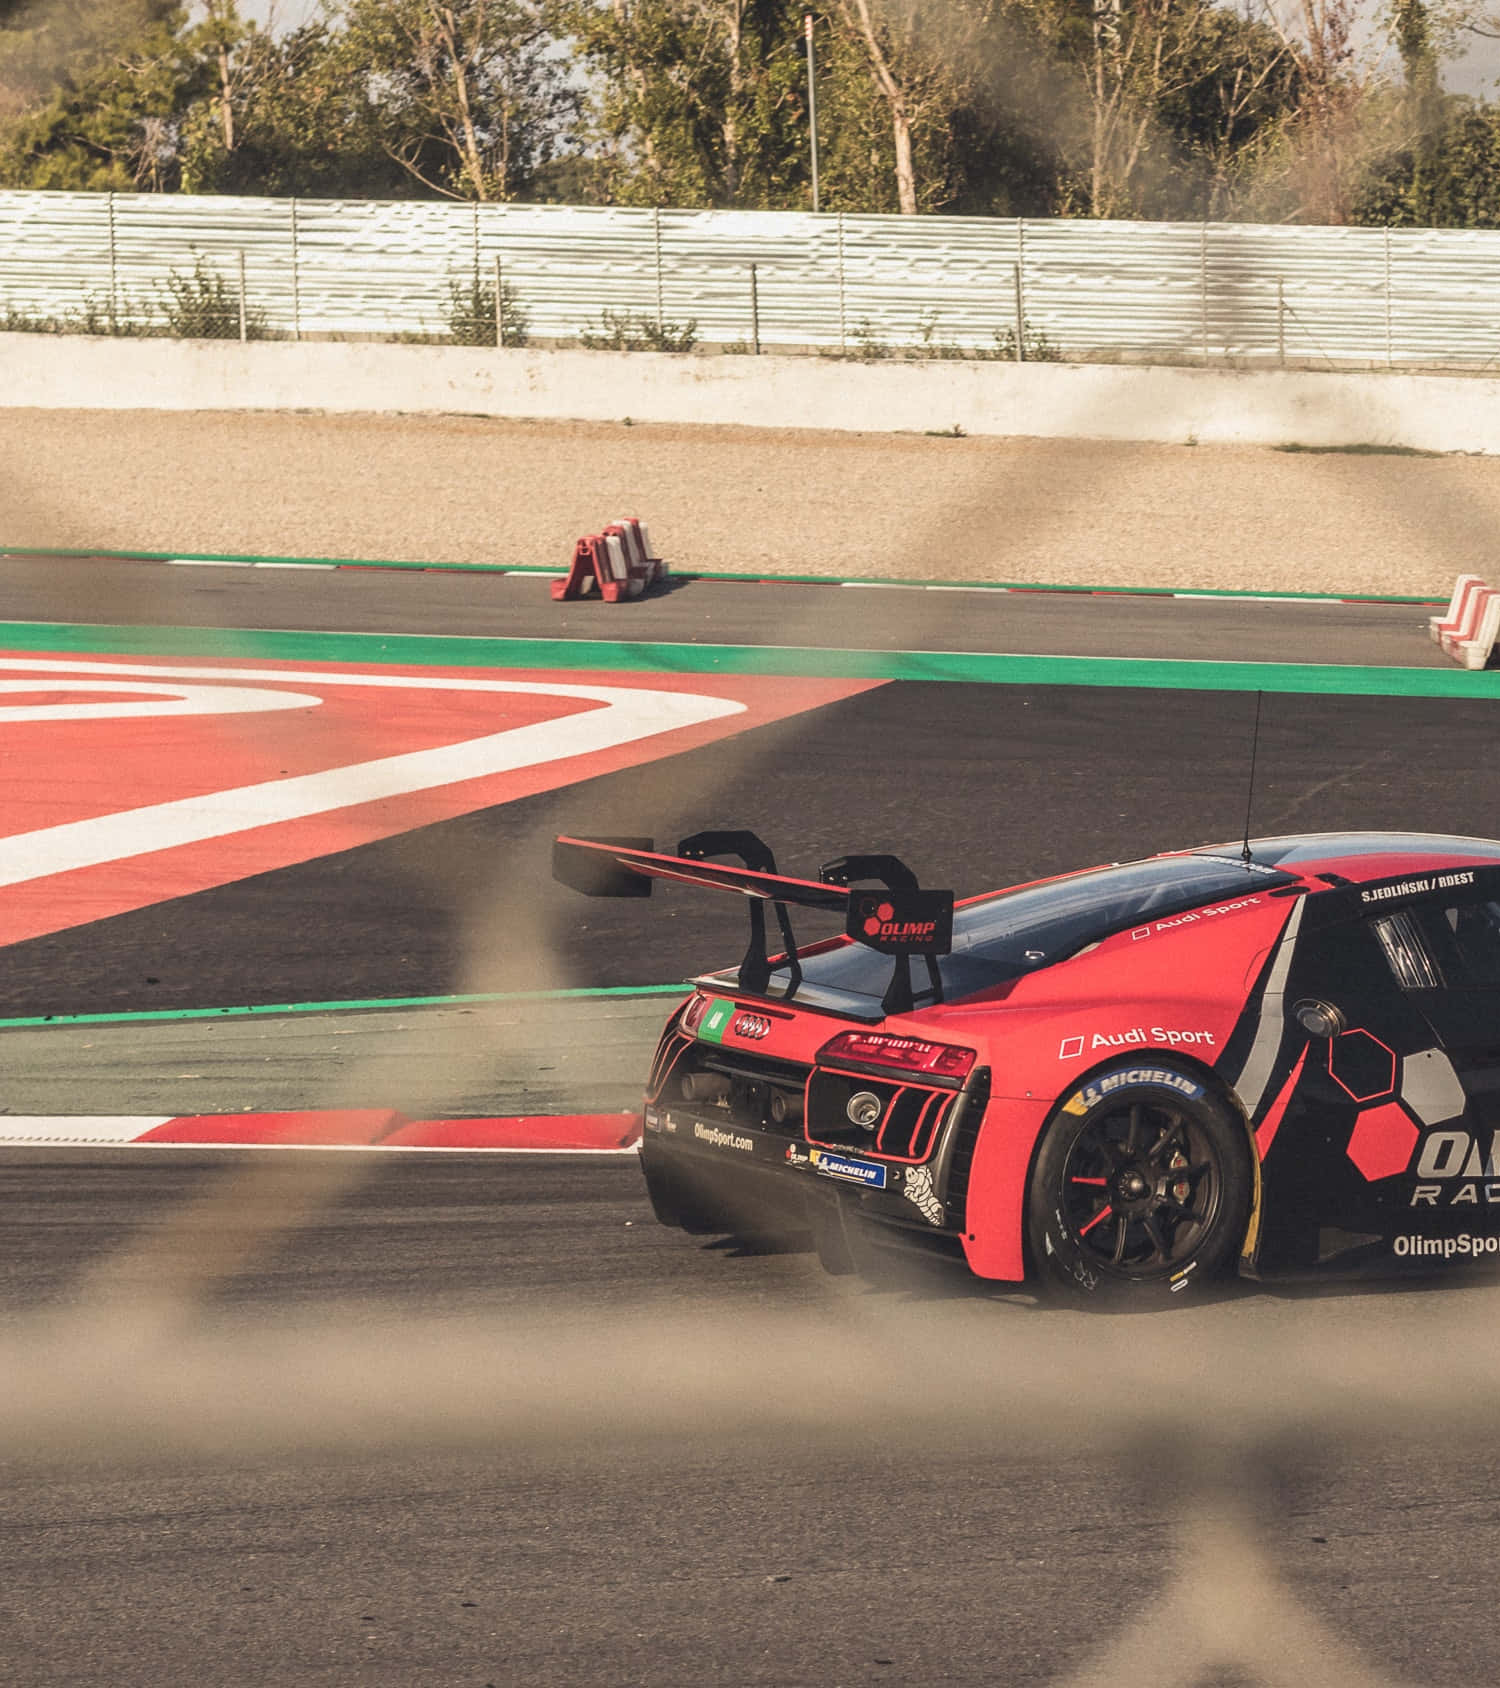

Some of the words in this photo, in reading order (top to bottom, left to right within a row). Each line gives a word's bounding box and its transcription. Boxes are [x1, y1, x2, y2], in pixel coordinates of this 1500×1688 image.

[1438, 872, 1474, 888] RDEST
[1156, 913, 1200, 931] Audi
[1202, 897, 1261, 917] Sport
[881, 922, 935, 935] OLIMP
[1092, 1028, 1147, 1049] Audi
[1150, 1027, 1215, 1045] Sport
[1101, 1070, 1197, 1095] MICHELIN
[694, 1122, 753, 1151] OlimpSport.com
[829, 1162, 877, 1179] MICHELIN
